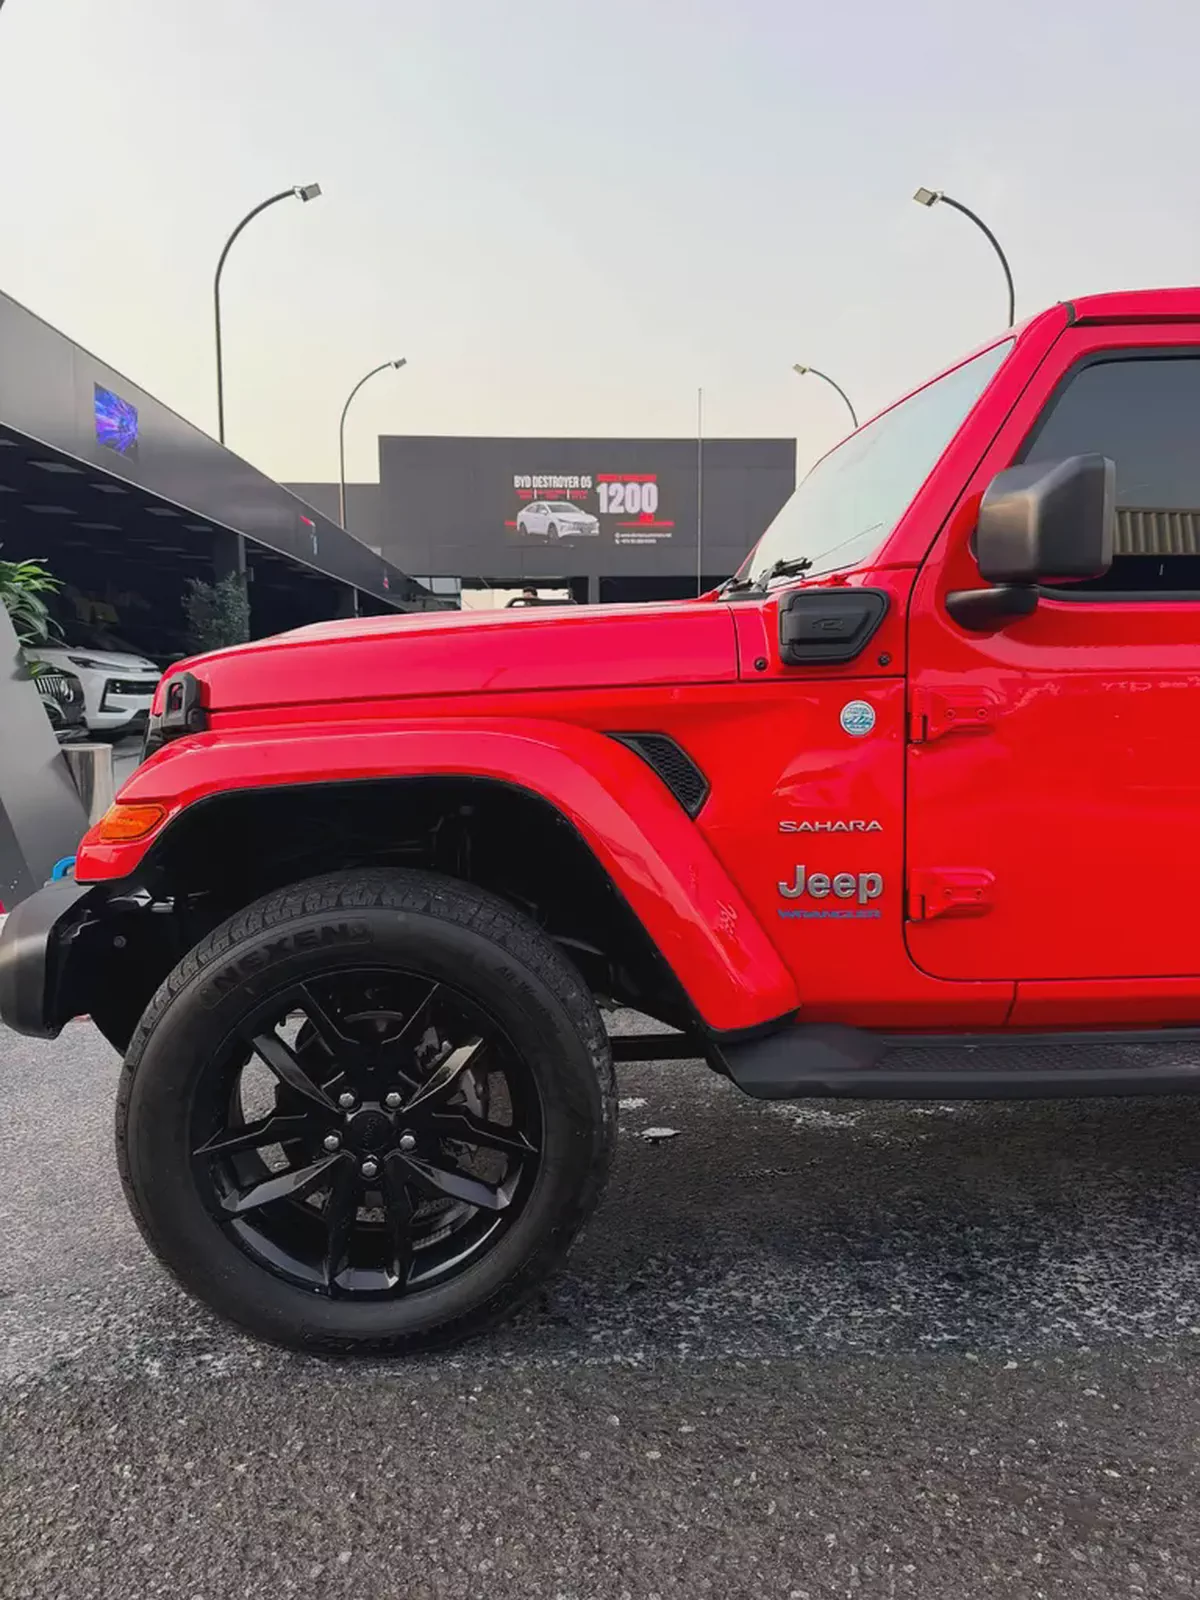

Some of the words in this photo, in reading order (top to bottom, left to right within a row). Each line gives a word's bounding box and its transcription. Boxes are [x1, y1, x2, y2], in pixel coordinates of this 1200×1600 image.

[514, 475, 532, 488] BYD
[532, 475, 579, 488] DESTROYER
[580, 476, 593, 488] 05
[596, 482, 658, 513] 1200
[778, 820, 883, 833] SAHARA
[778, 864, 884, 904] Jeep
[778, 908, 882, 919] WRANGLER
[214, 922, 348, 993] NEXEN
